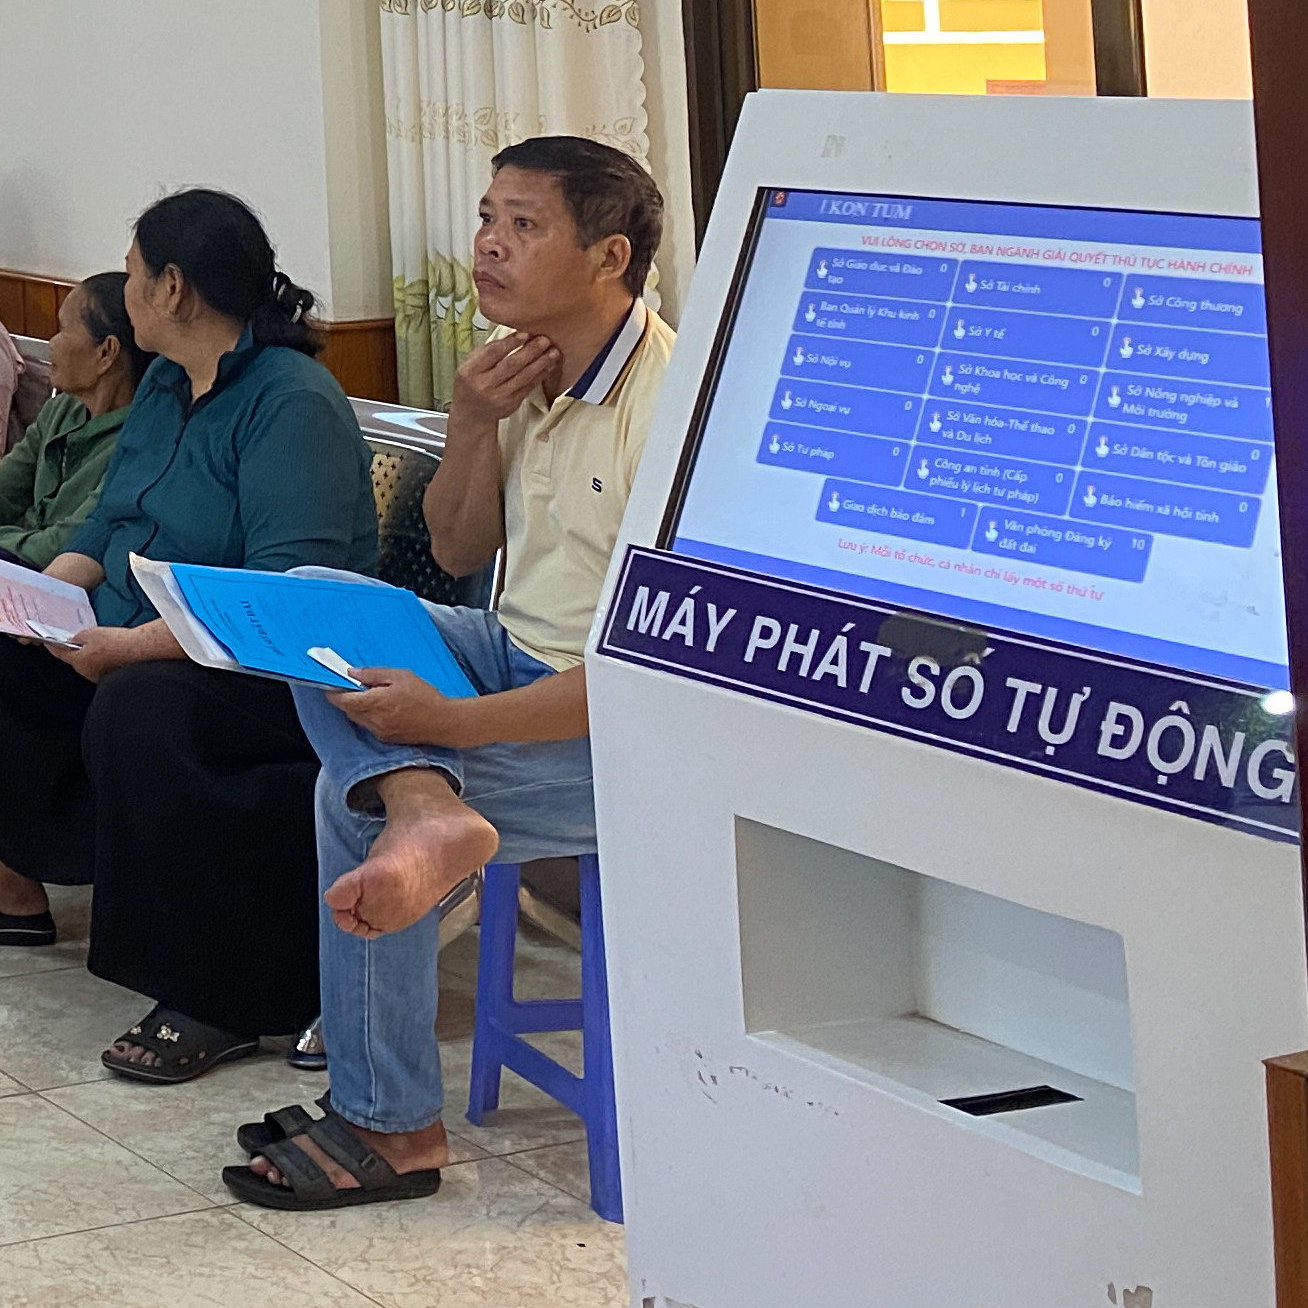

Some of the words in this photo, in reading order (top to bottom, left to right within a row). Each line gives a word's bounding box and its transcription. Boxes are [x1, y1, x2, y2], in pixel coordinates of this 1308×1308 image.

[871, 203, 914, 219] TUM
[862, 236, 880, 246] VUI
[970, 244, 993, 255] BAN
[1168, 258, 1206, 272] HÀNH
[1210, 261, 1253, 275] CHÍNH
[940, 263, 947, 272] 0
[1103, 278, 1111, 287] 0
[819, 301, 837, 312] Ban
[877, 306, 897, 318] Khu
[1166, 297, 1197, 312] Công
[985, 328, 992, 336] Y
[1092, 327, 1099, 336] 0
[1153, 346, 1176, 361] Xây
[917, 355, 924, 364] 0
[975, 366, 1000, 379] Khoa
[1040, 375, 1069, 389] Công
[1080, 375, 1087, 384] 0
[905, 402, 912, 410] 0
[1030, 423, 1055, 435] thao
[1068, 424, 1075, 434] 0
[956, 431, 972, 441] Du
[893, 448, 900, 456] 0
[1251, 450, 1260, 460] 0
[1196, 455, 1217, 468] Tôn
[964, 464, 977, 473] an
[1055, 473, 1063, 483] 0
[843, 500, 864, 512] Giao
[1239, 502, 1247, 512] 0
[1132, 539, 1145, 550] 10
[625, 584, 738, 655] MÁY
[744, 614, 892, 695] PHÁT
[900, 648, 994, 720] SỐ
[1004, 676, 1089, 754] TỰ
[1098, 699, 1295, 803] ĐỘNG
